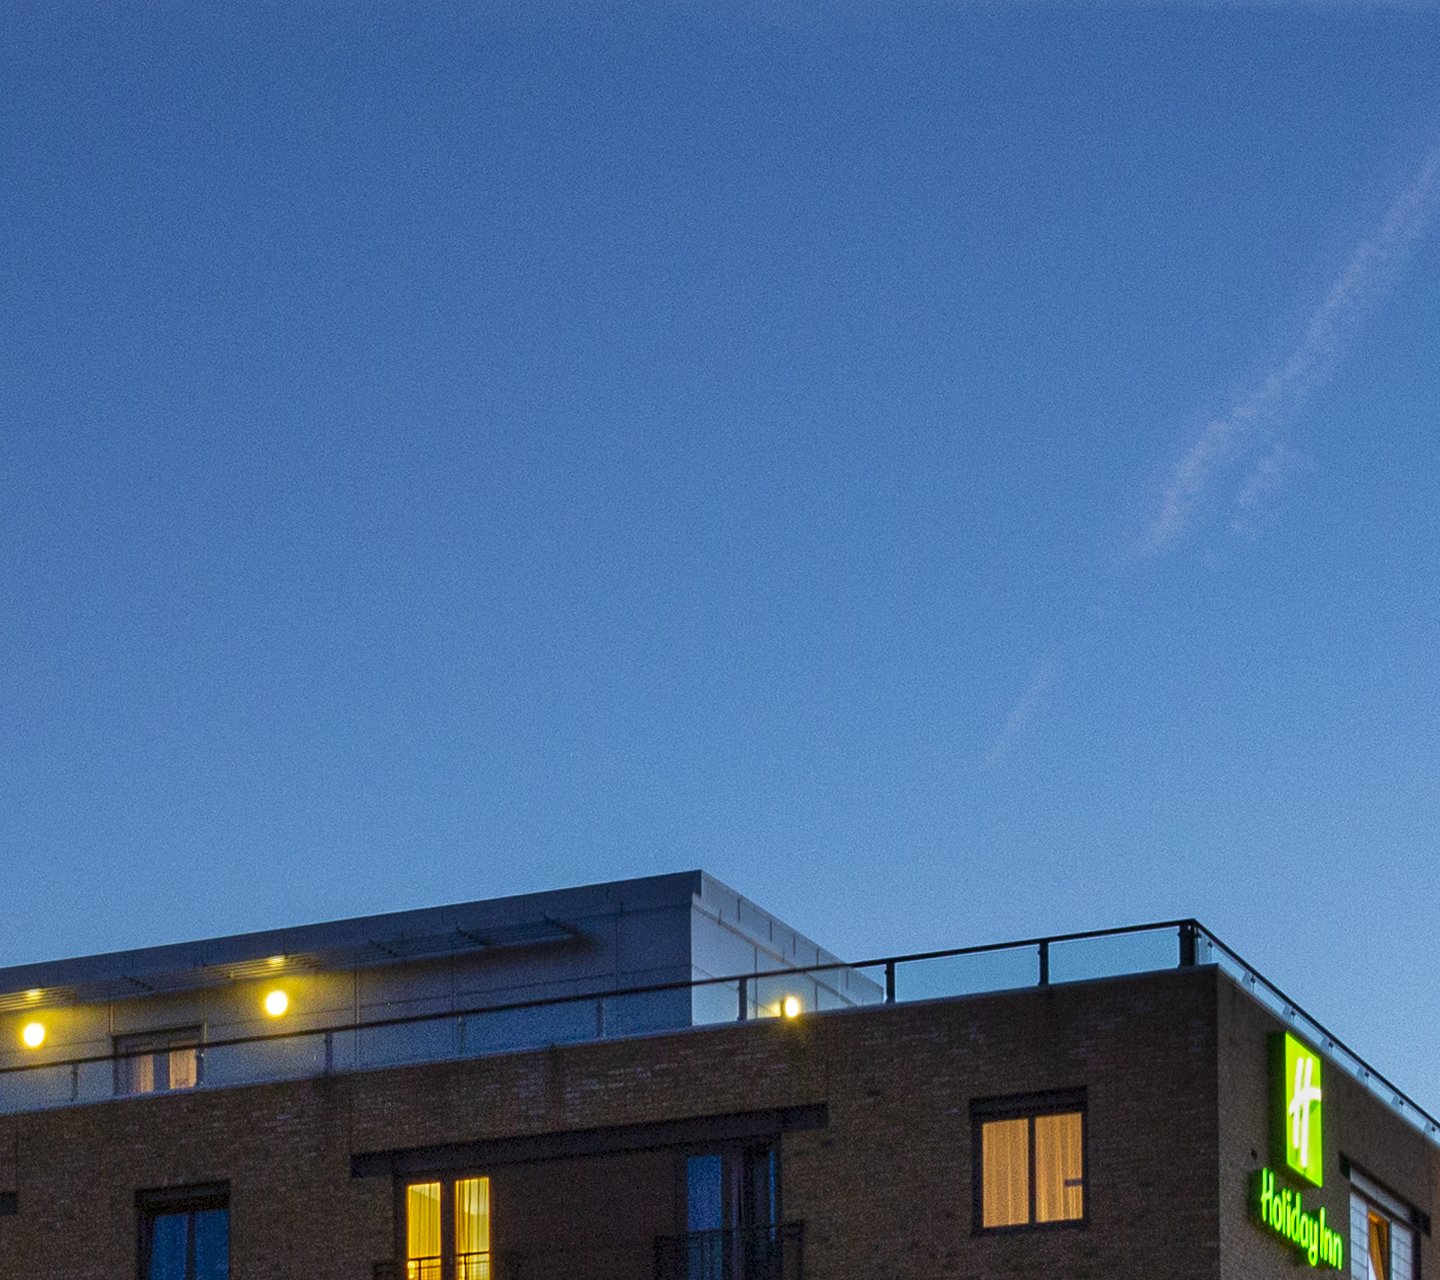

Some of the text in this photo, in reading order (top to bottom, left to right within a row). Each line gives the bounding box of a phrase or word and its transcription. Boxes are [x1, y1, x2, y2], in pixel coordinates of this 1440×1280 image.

[1288, 1056, 1323, 1169] H
[1260, 1167, 1343, 1271] Holiday Inn
